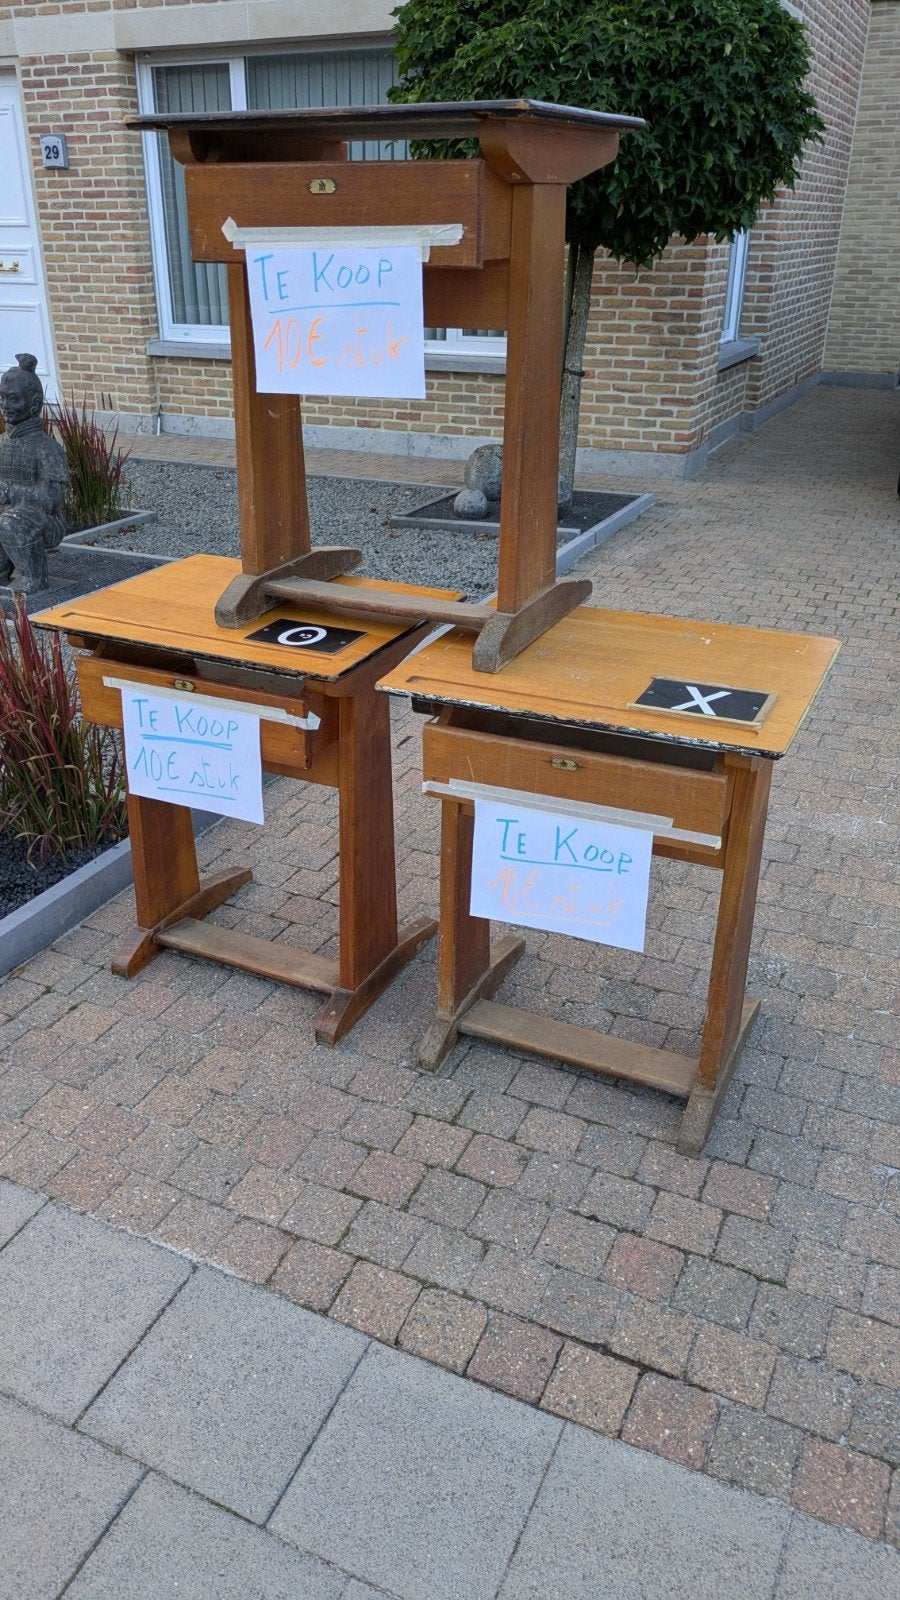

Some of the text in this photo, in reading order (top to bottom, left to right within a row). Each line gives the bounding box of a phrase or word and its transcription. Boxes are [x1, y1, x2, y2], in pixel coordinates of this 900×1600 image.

[44, 145, 59, 160] 29
[253, 251, 394, 301] TE KOOP
[261, 315, 329, 373] 10€
[131, 698, 240, 740] TE KOOP
[132, 746, 181, 782] 10€
[496, 818, 633, 874] TE KOOP
